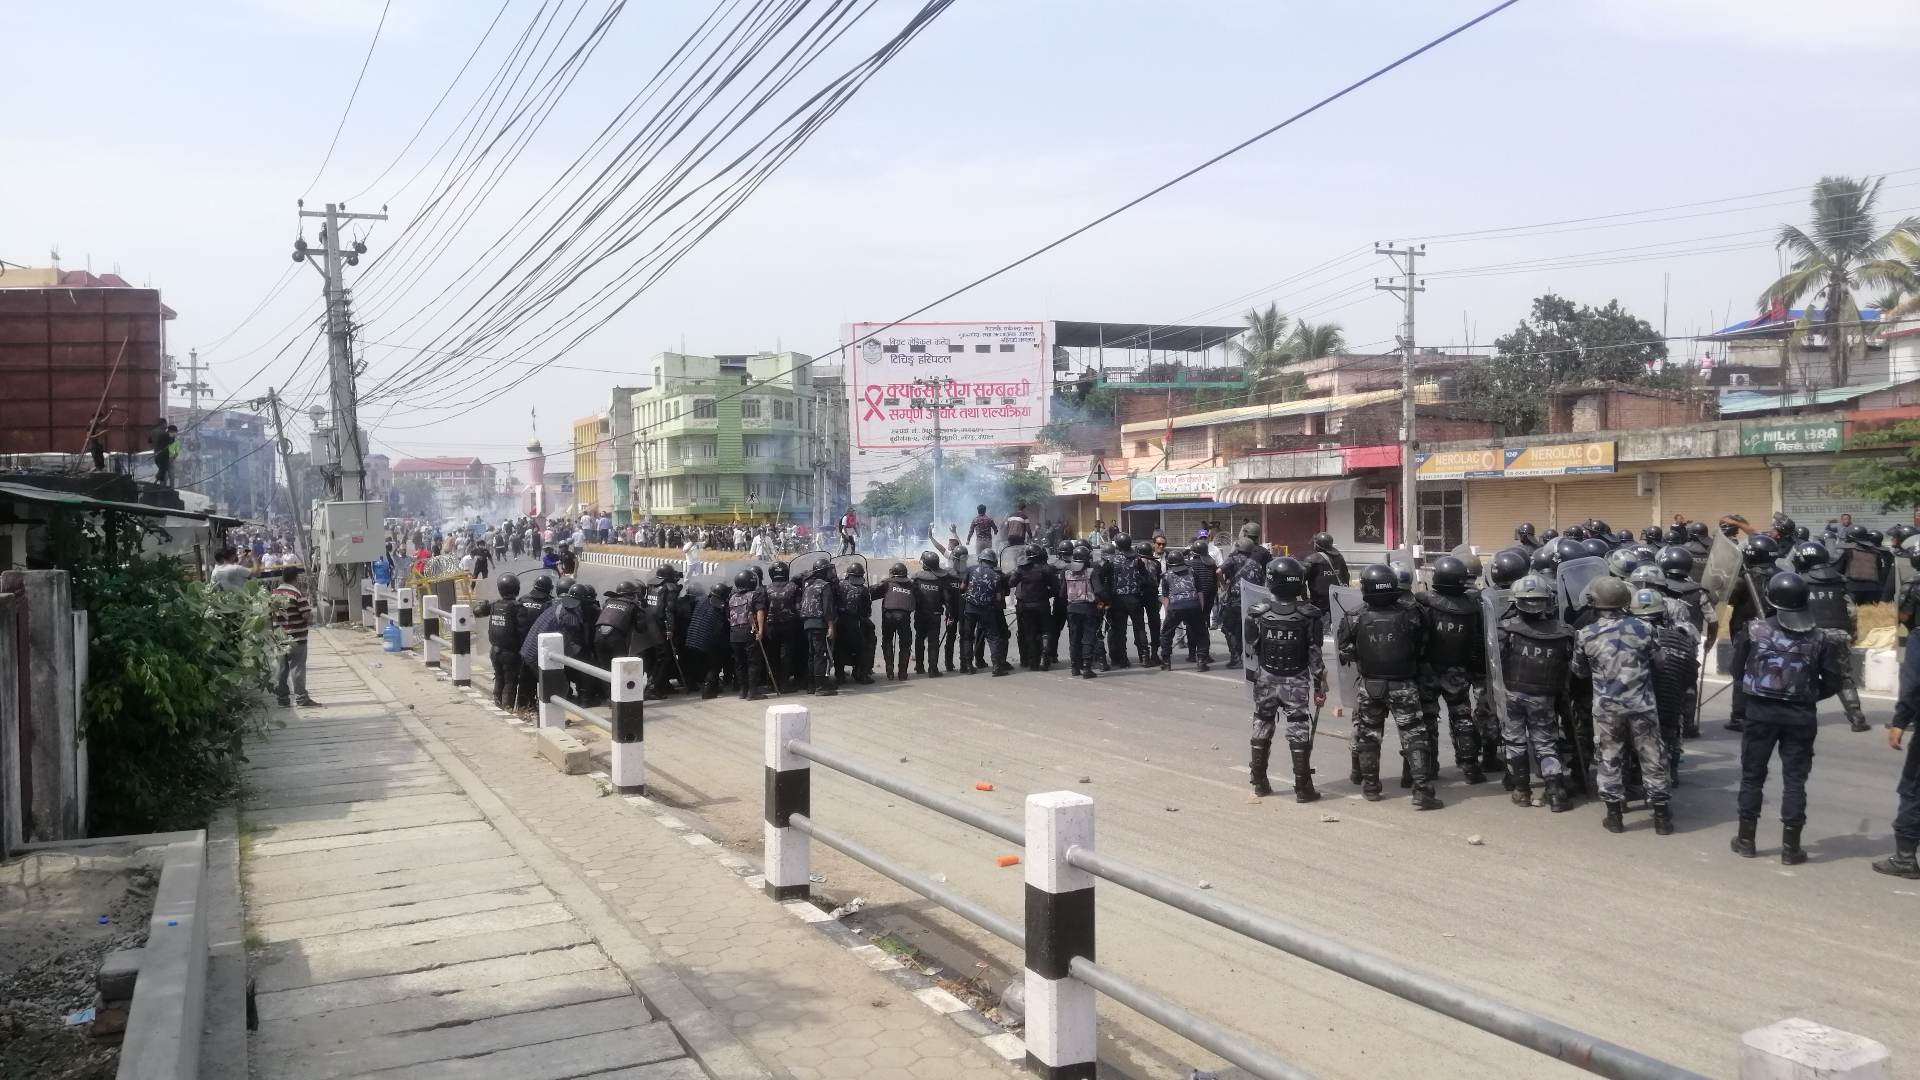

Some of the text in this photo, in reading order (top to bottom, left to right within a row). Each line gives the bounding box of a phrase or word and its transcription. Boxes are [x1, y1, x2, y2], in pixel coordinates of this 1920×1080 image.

[926, 408, 957, 419] उचार
[959, 407, 979, 418] तथा
[1763, 429, 1796, 441] MILK
[1532, 446, 1584, 460] NEROLAC
[1435, 453, 1480, 466] NEROLAC
[892, 586, 911, 594] POLICE
[920, 583, 939, 591] POLICE
